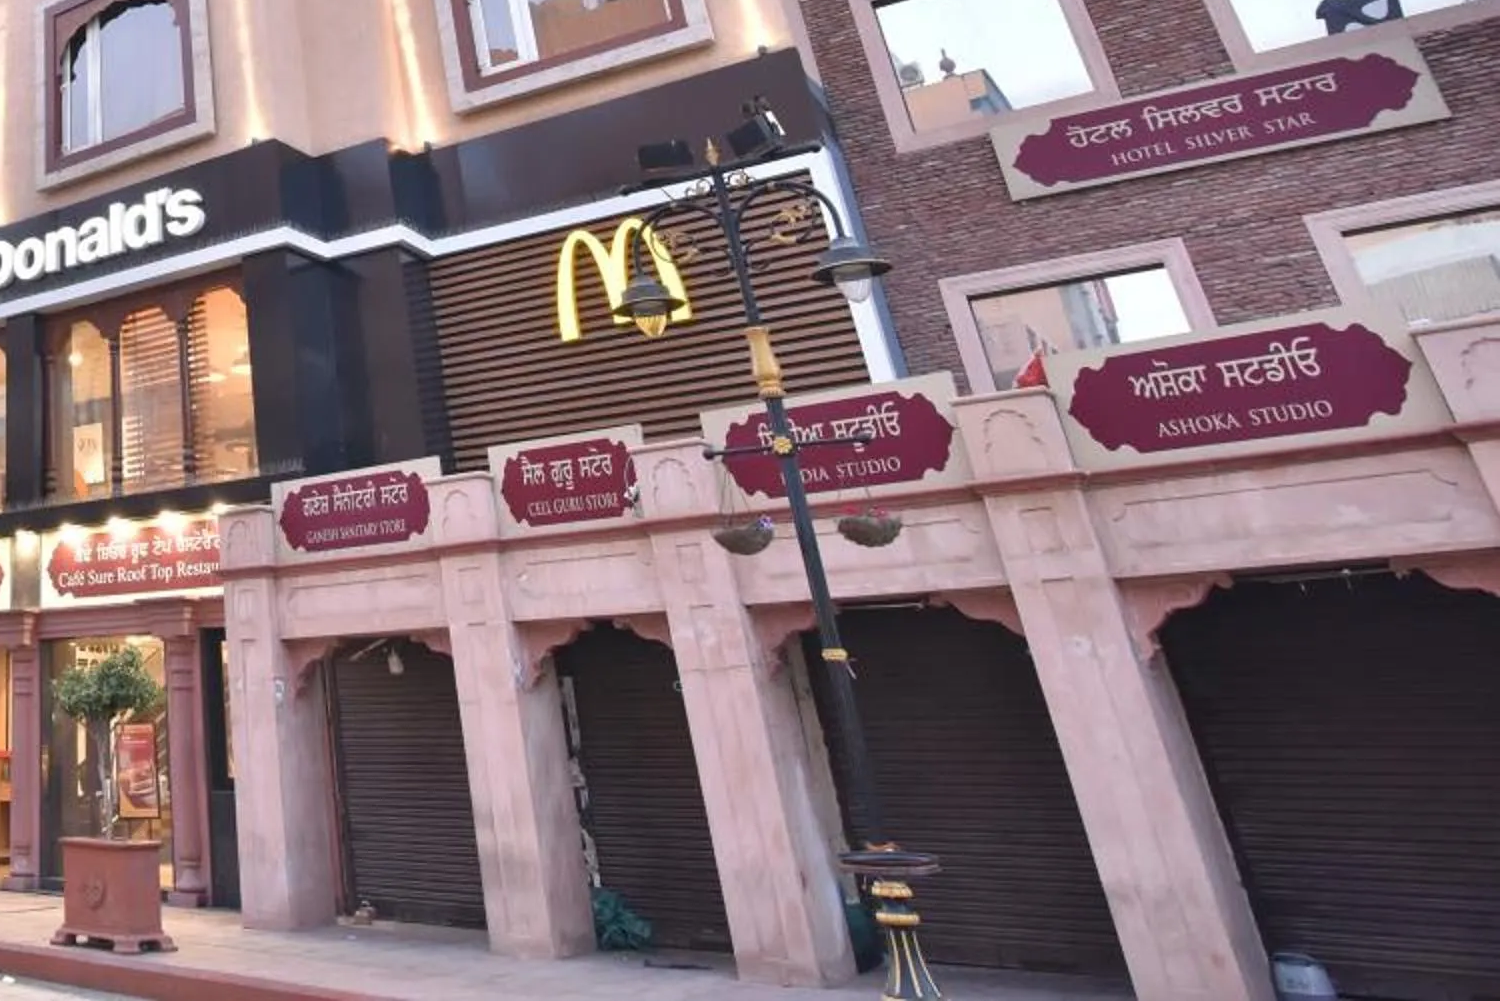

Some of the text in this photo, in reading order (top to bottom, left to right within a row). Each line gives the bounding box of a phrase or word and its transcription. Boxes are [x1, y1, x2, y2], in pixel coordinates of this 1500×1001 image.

[1065, 71, 1340, 149] ਹੋਟਲ ਸਿਲਵਰ ਸਟਾਰ
[1109, 111, 1318, 168] HOTEL SILVER STAR
[1157, 399, 1334, 440] ASHOKA STUDIO
[779, 456, 901, 486] IDIA STUDIO
[59, 570, 85, 588] Café
[87, 570, 115, 585] Sure
[117, 564, 149, 582] Roof
[150, 563, 173, 582] Top
